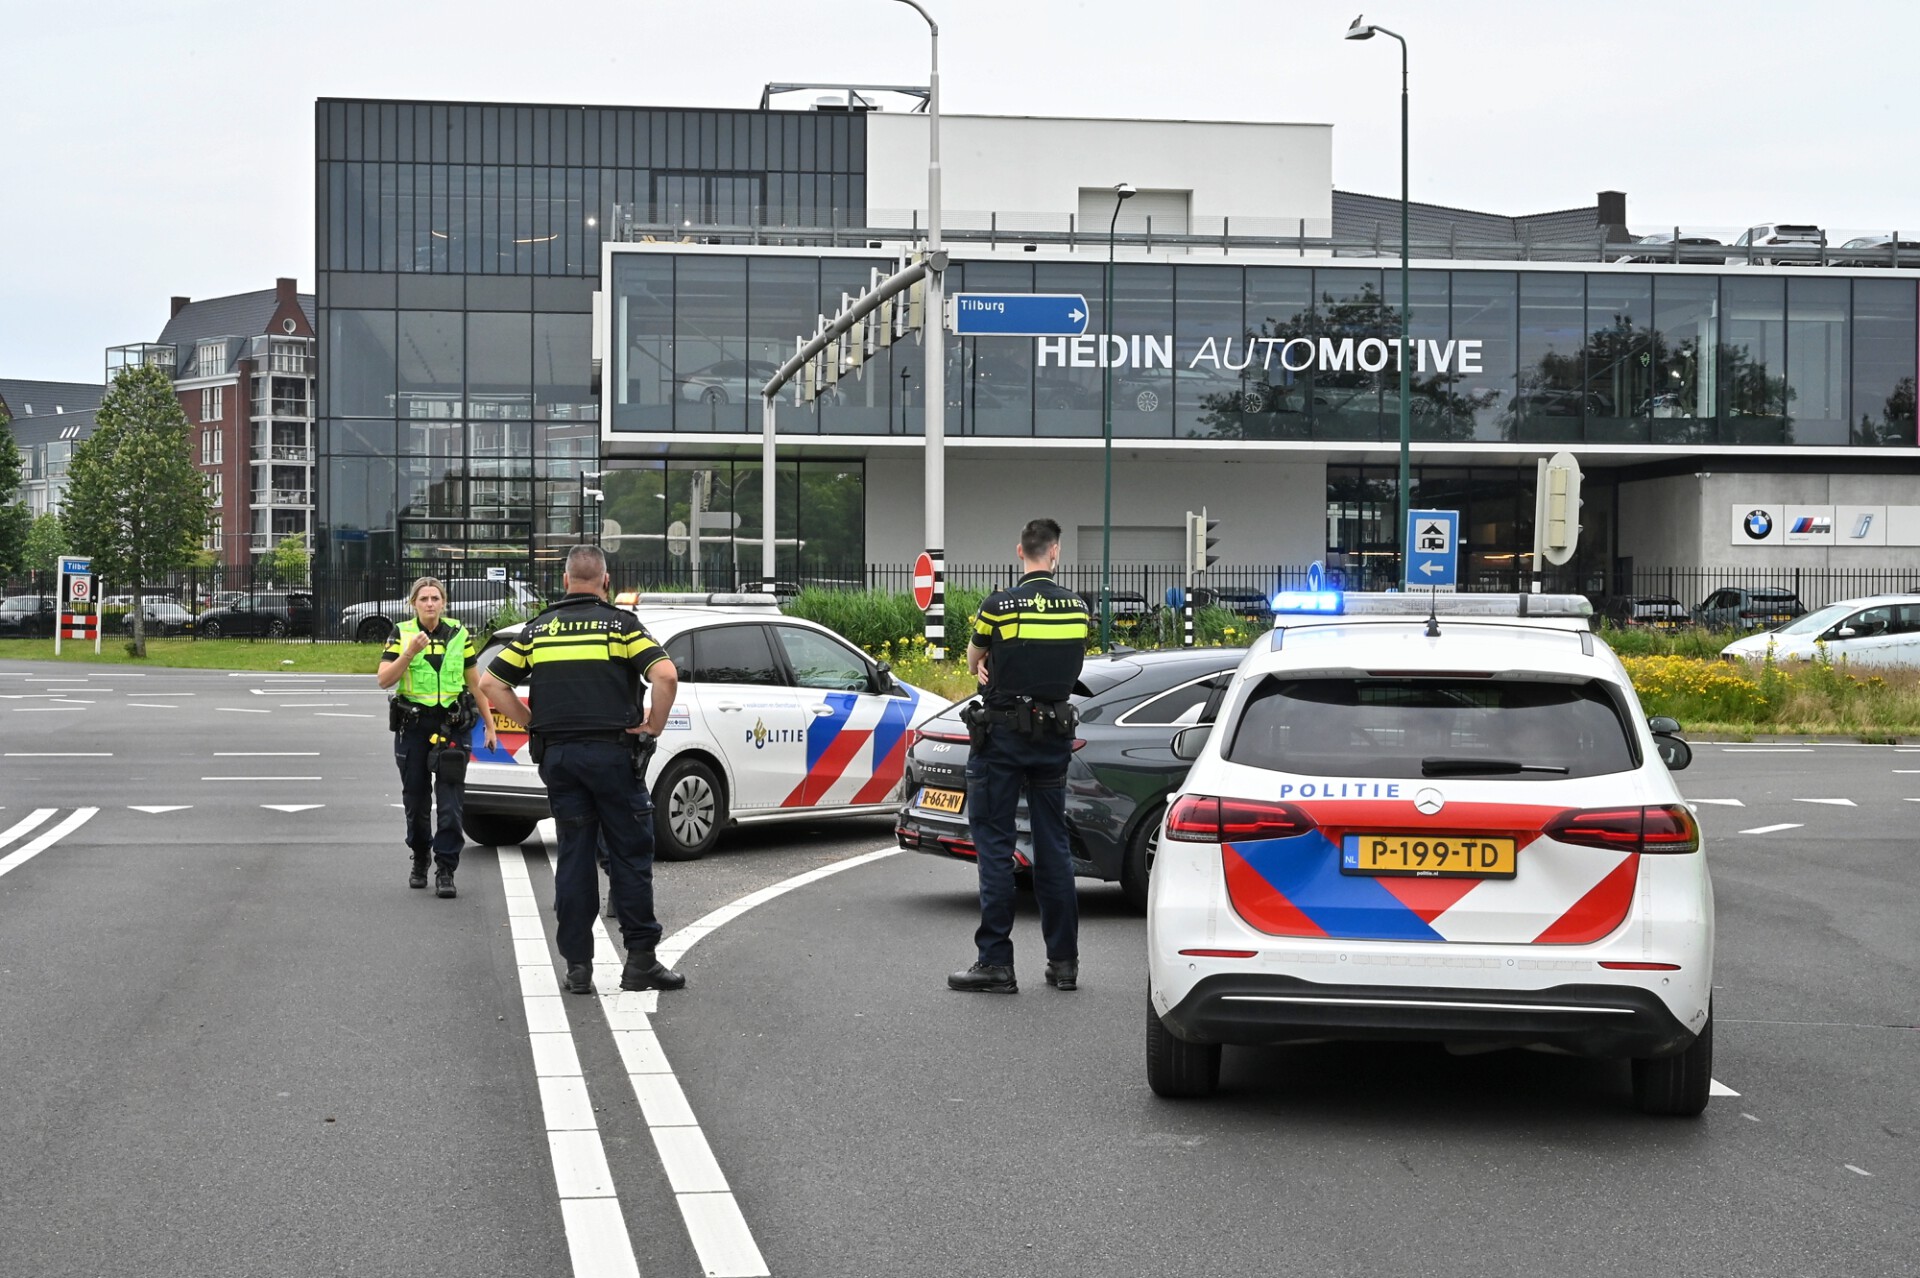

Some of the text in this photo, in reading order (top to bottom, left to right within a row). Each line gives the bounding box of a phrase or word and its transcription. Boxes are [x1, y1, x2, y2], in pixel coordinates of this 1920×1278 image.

[960, 299, 1005, 314] Tilburg
[1037, 334, 1484, 373] HEDIN AUTOMOTIVE
[1027, 596, 1080, 611] POLITIE
[542, 618, 599, 635] POLITIE
[746, 725, 803, 749] POLITIE
[922, 790, 961, 809] R-662-NV
[1279, 783, 1400, 799] POLITIE
[1345, 855, 1357, 864] NL
[1372, 840, 1499, 868] P-199-TD
